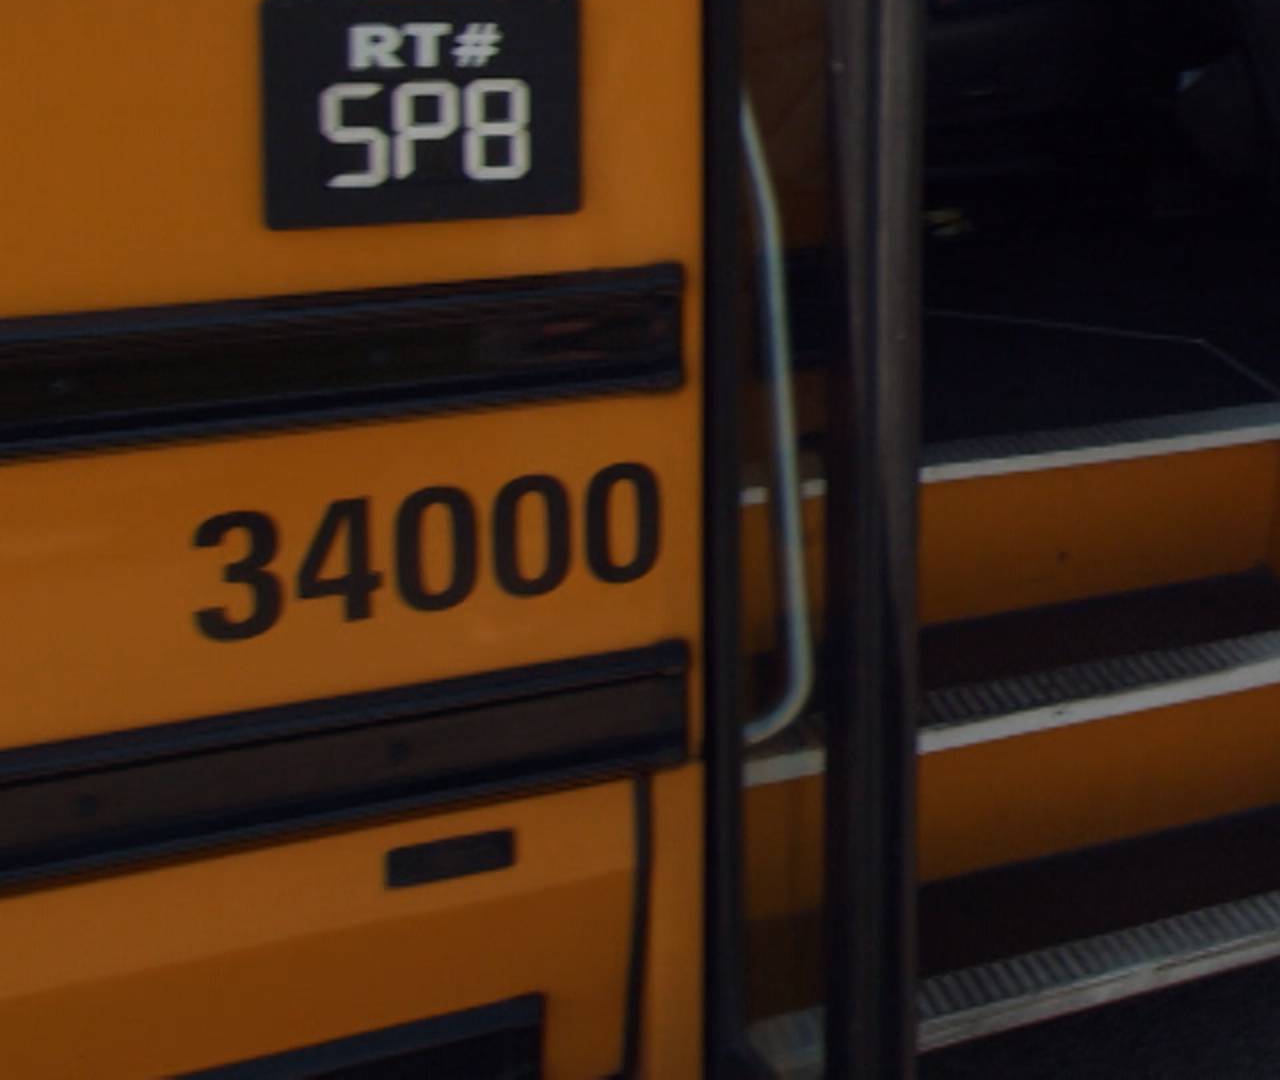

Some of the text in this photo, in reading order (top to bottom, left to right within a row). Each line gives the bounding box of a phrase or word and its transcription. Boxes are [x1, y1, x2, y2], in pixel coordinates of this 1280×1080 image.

[348, 22, 503, 69] RT#
[319, 78, 531, 188] SP8
[190, 461, 662, 644] 34000
